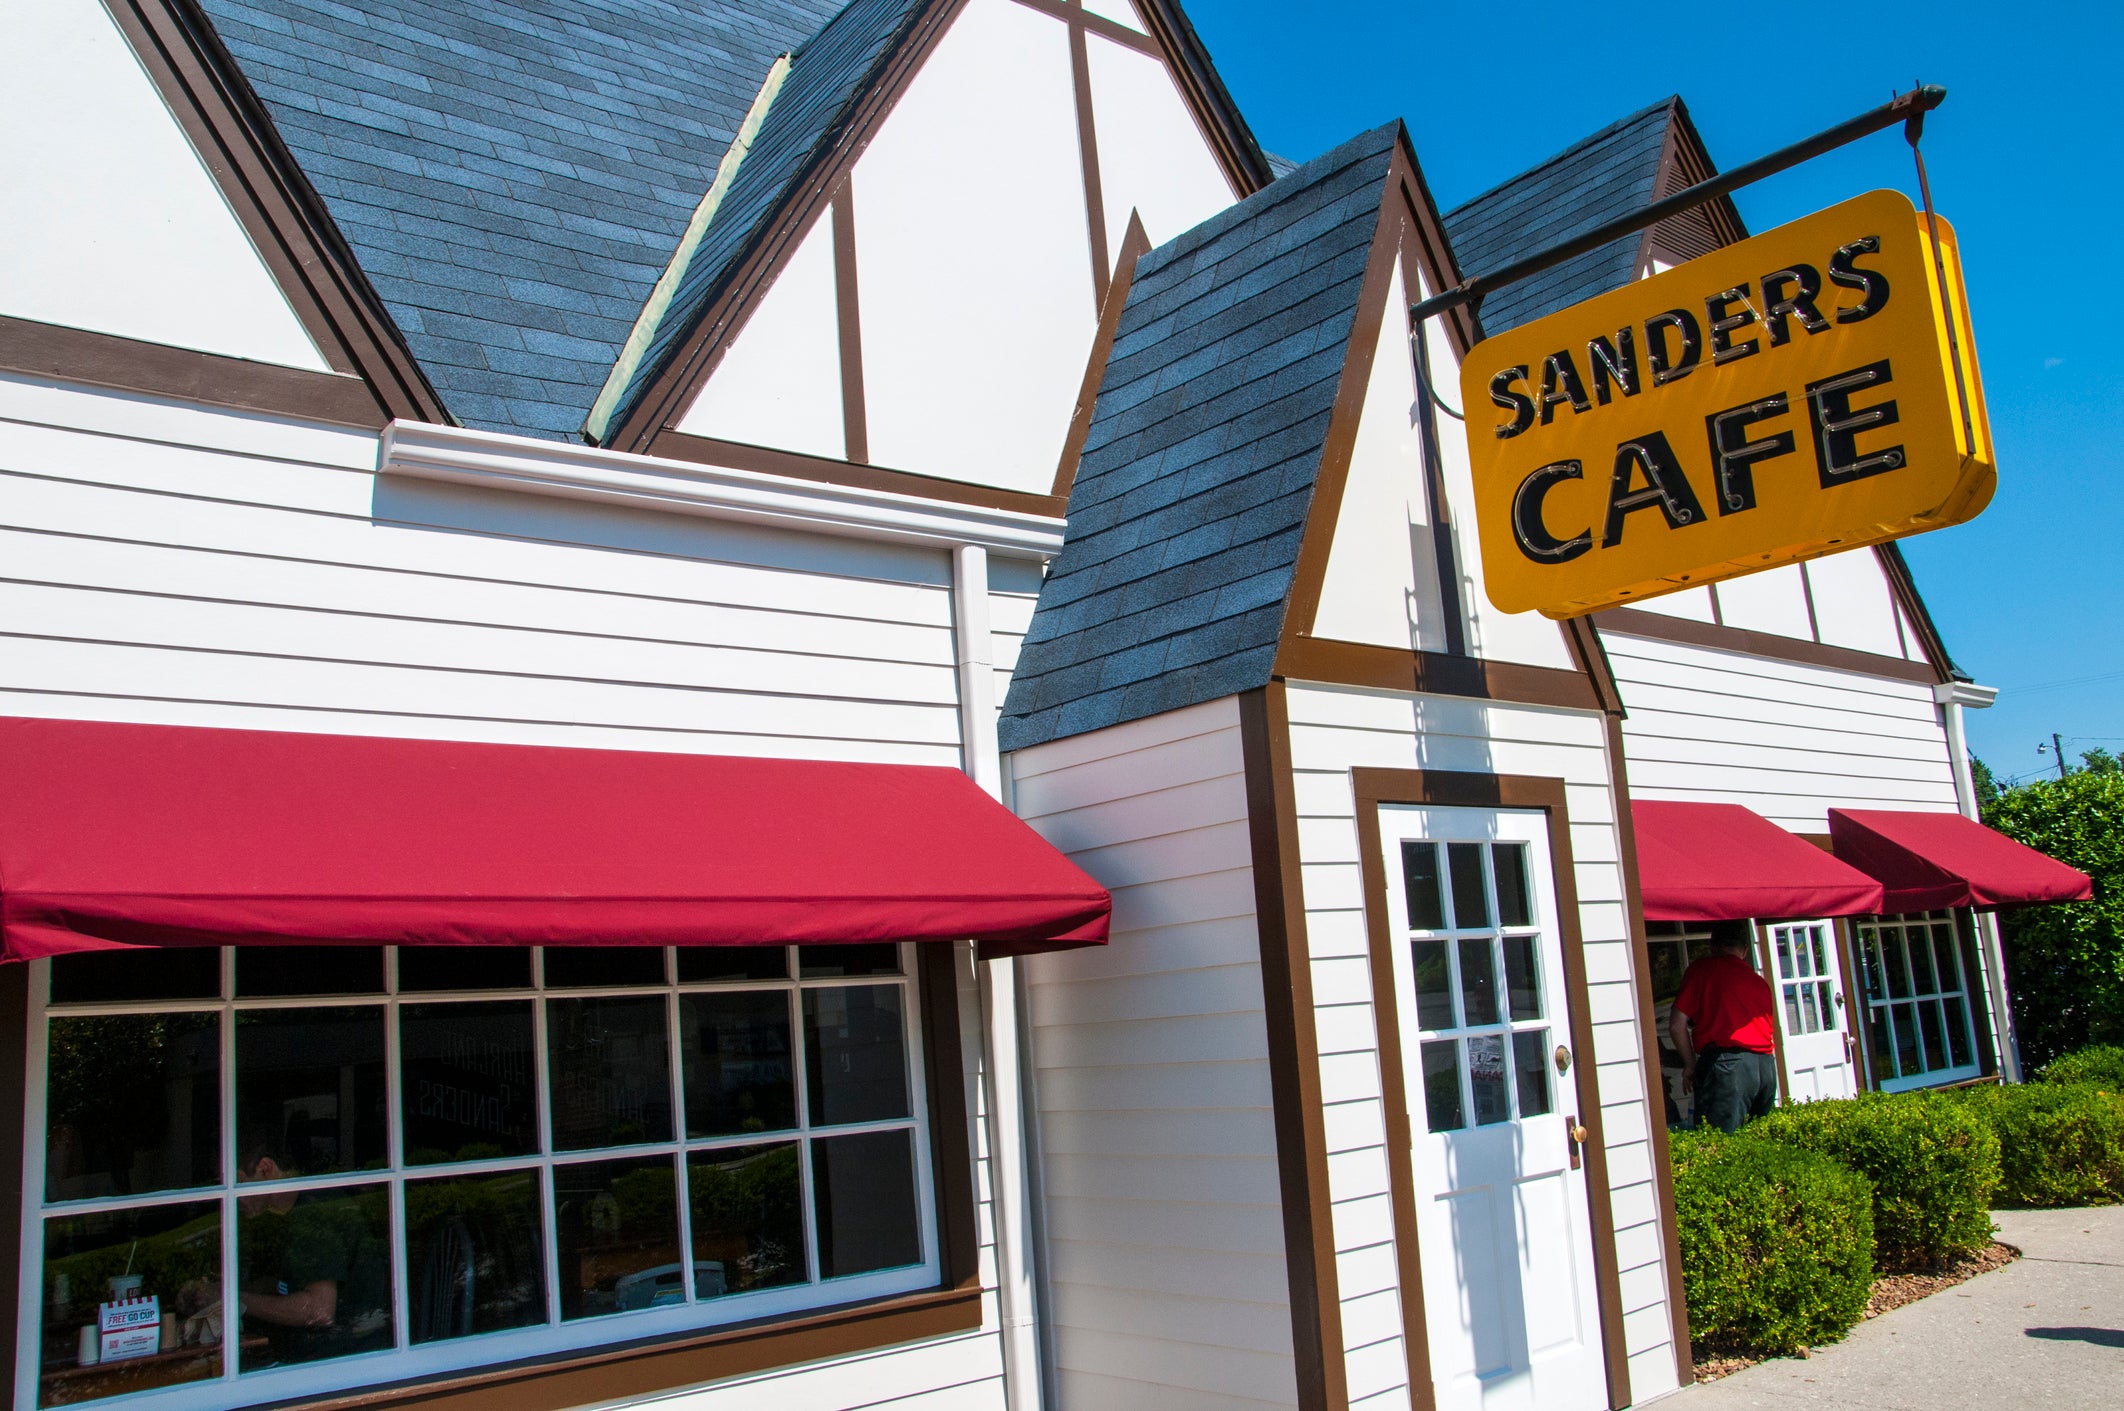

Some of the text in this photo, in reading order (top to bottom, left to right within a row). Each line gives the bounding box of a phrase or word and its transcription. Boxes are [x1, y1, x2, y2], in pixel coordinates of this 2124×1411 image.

[1489, 235, 1890, 439] SANDERS
[1512, 359, 1906, 564] CAFE
[108, 1314, 127, 1325] FREE
[128, 1312, 139, 1322] GO
[140, 1310, 155, 1320] CUP
